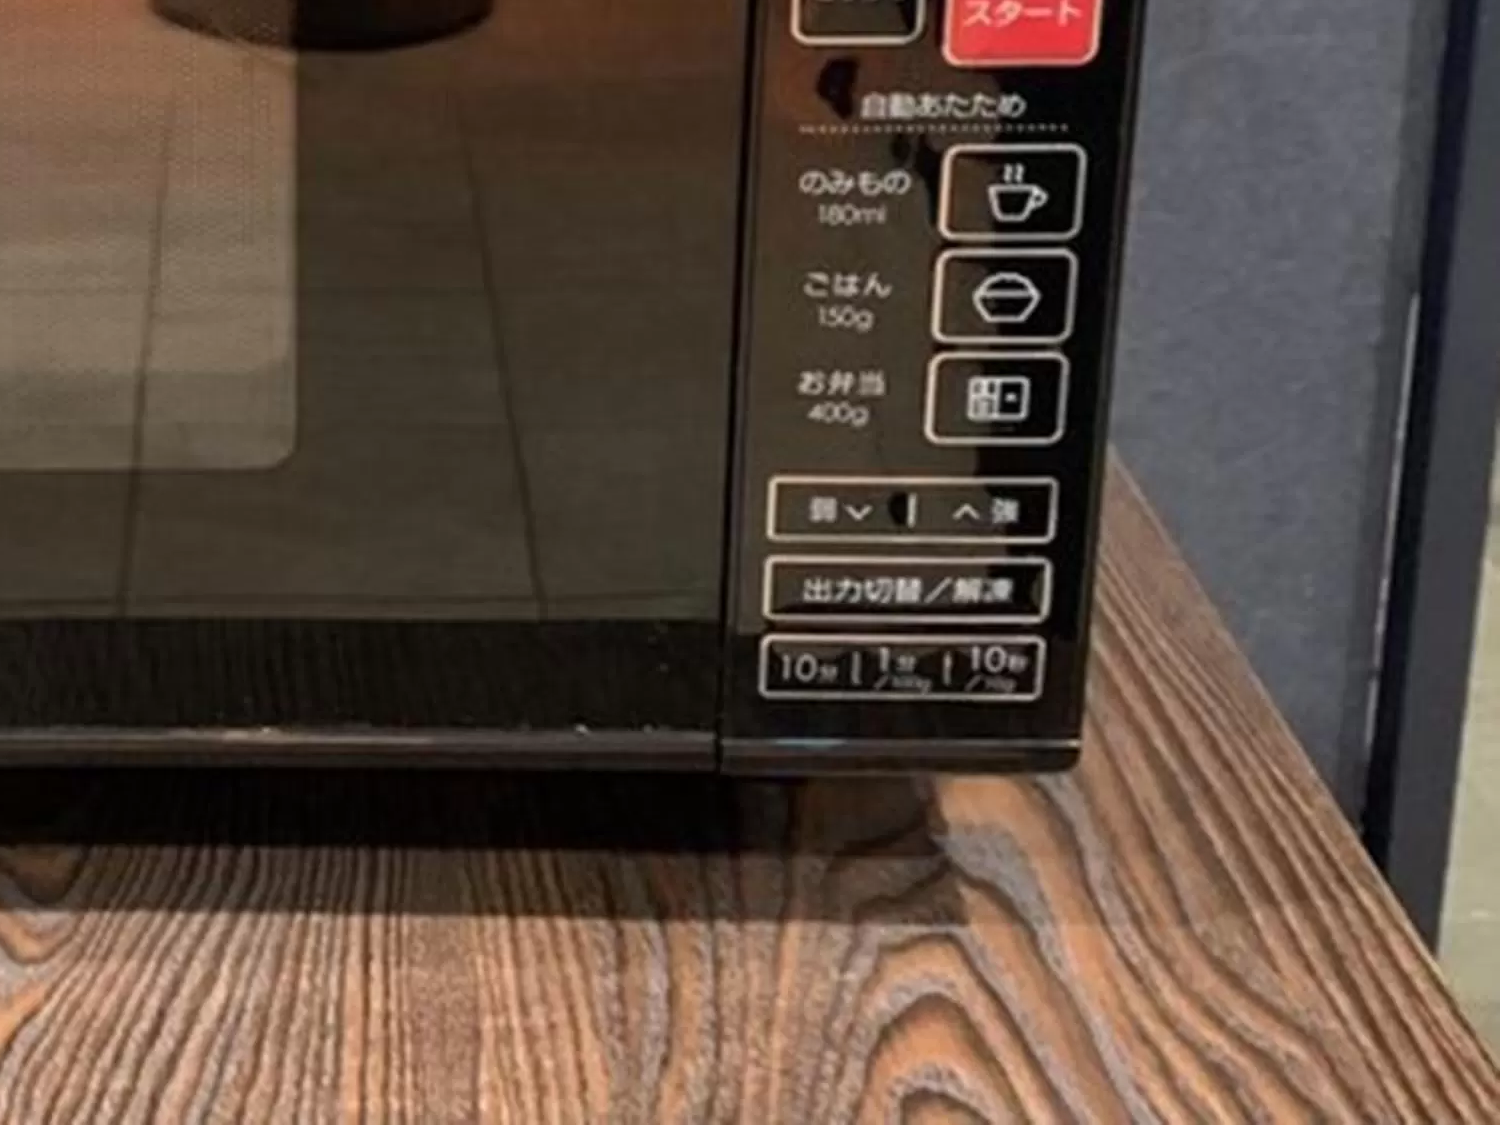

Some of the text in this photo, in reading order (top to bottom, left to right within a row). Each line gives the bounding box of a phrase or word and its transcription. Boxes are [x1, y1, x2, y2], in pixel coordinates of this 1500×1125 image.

[860, 91, 1027, 121] 自動あたため
[799, 169, 911, 196] のみもの
[803, 271, 892, 299] ごはん
[817, 306, 874, 333] 150g
[798, 370, 886, 396] お弁当
[807, 403, 869, 427] 400g
